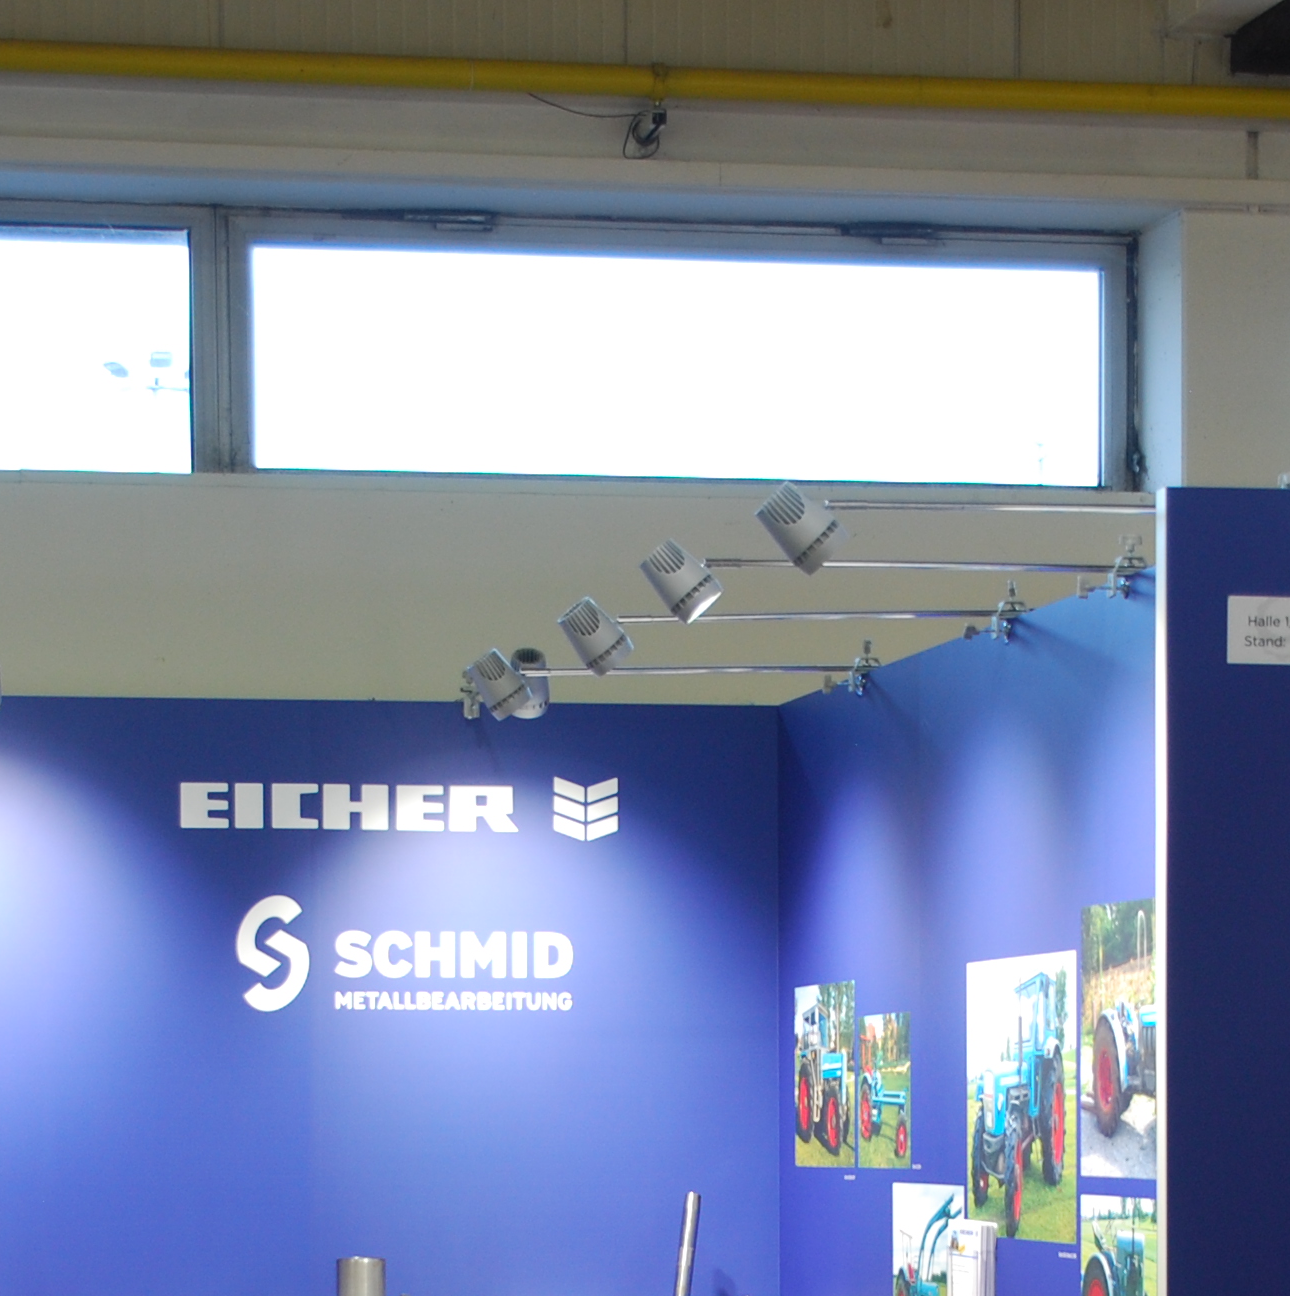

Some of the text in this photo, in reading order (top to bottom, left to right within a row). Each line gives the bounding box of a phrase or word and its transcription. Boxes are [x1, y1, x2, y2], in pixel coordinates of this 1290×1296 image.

[1248, 615, 1281, 628] Halle
[1244, 635, 1286, 648] Stand:
[179, 782, 520, 833] EICHER
[334, 929, 574, 979] SCHMID
[334, 991, 573, 1012] METALLBEARBEITUNG
